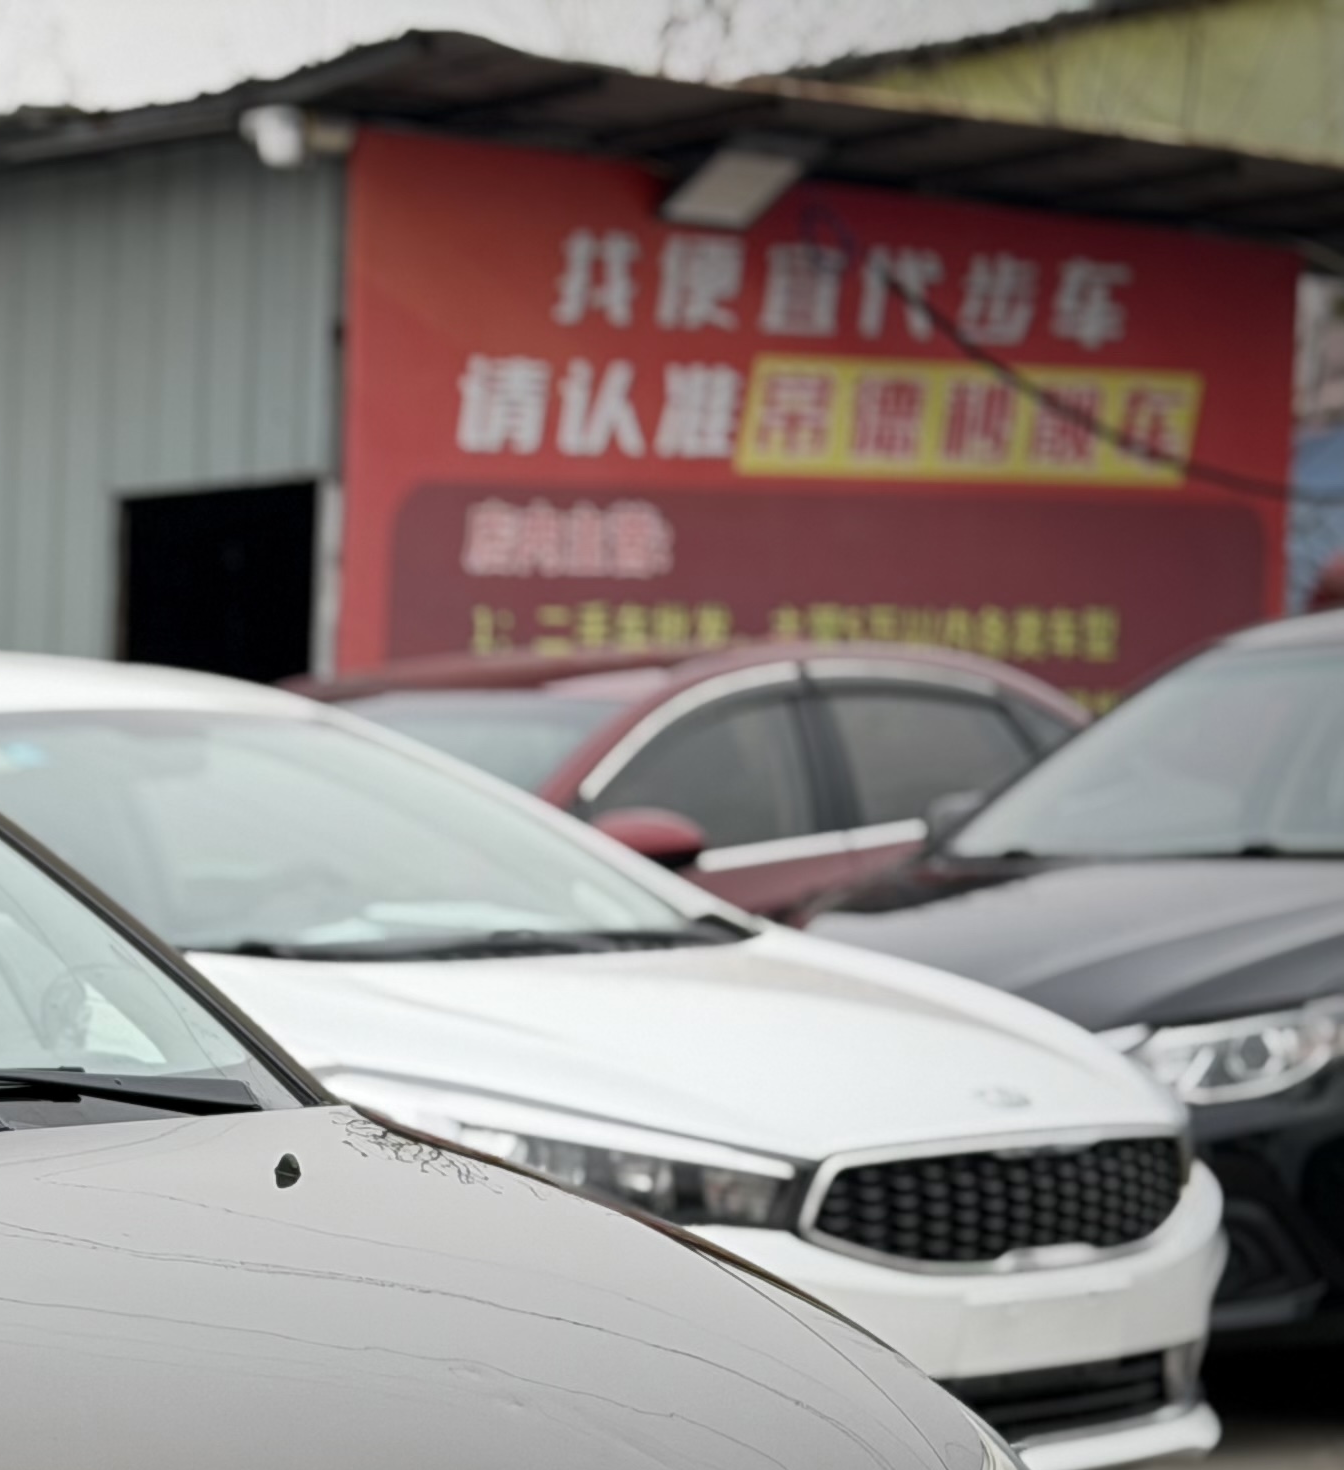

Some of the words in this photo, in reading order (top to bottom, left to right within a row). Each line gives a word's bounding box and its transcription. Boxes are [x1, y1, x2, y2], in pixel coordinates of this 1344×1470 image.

[551, 228, 1135, 352] 找便宜代步车
